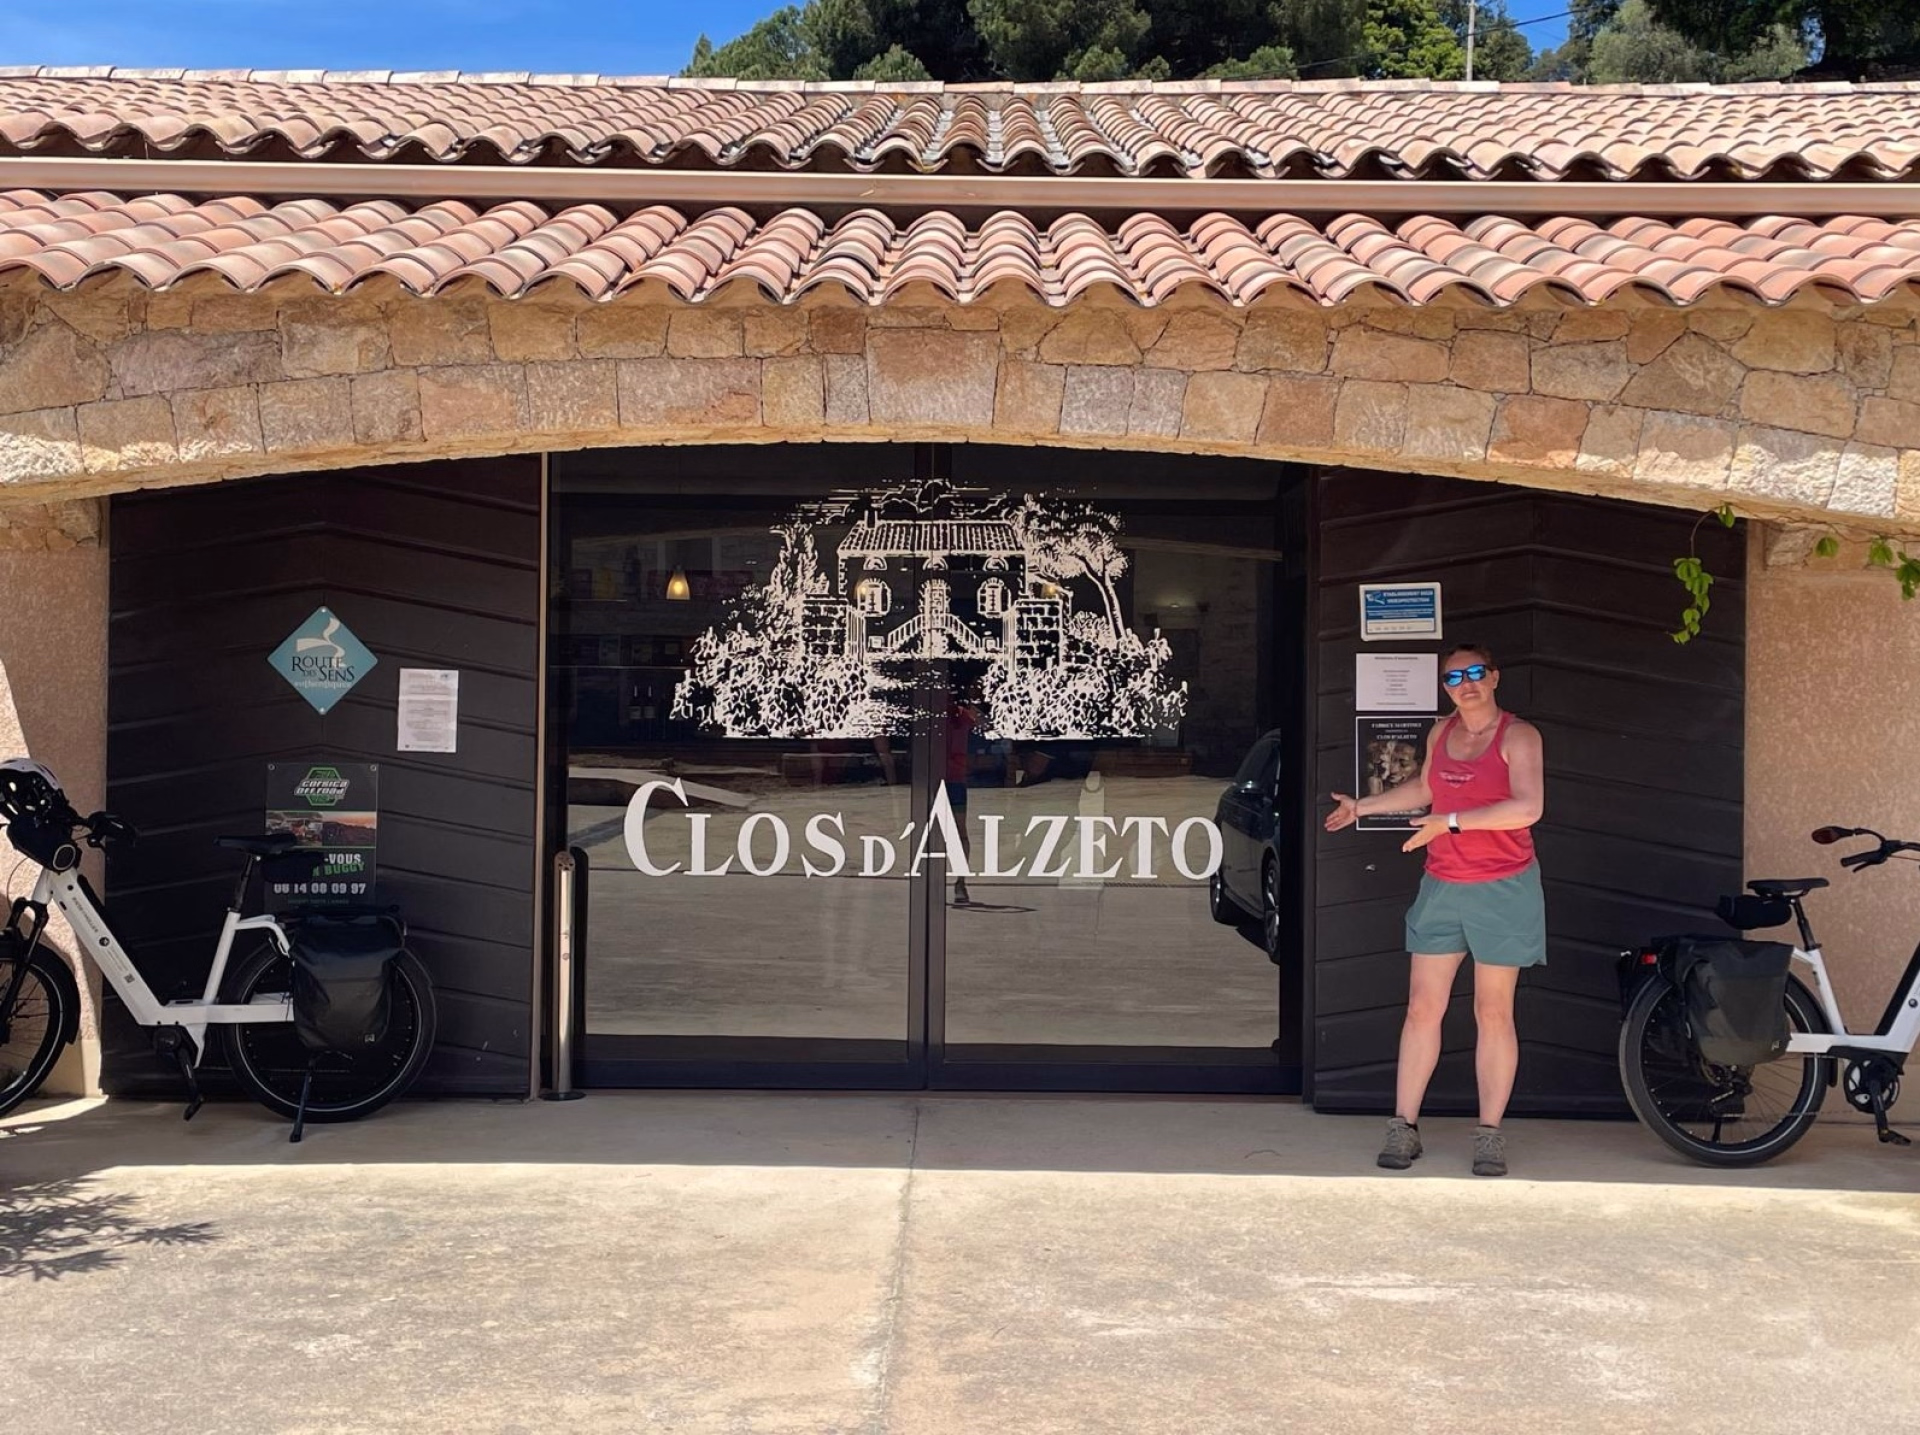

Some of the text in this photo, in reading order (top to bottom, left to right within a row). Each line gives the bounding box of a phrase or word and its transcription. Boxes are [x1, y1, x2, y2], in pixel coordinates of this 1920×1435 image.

[291, 655, 342, 672] ROUTE
[317, 665, 355, 682] SENS
[623, 777, 846, 880] CLOS
[324, 853, 361, 865] -VOUS
[293, 883, 307, 894] 14
